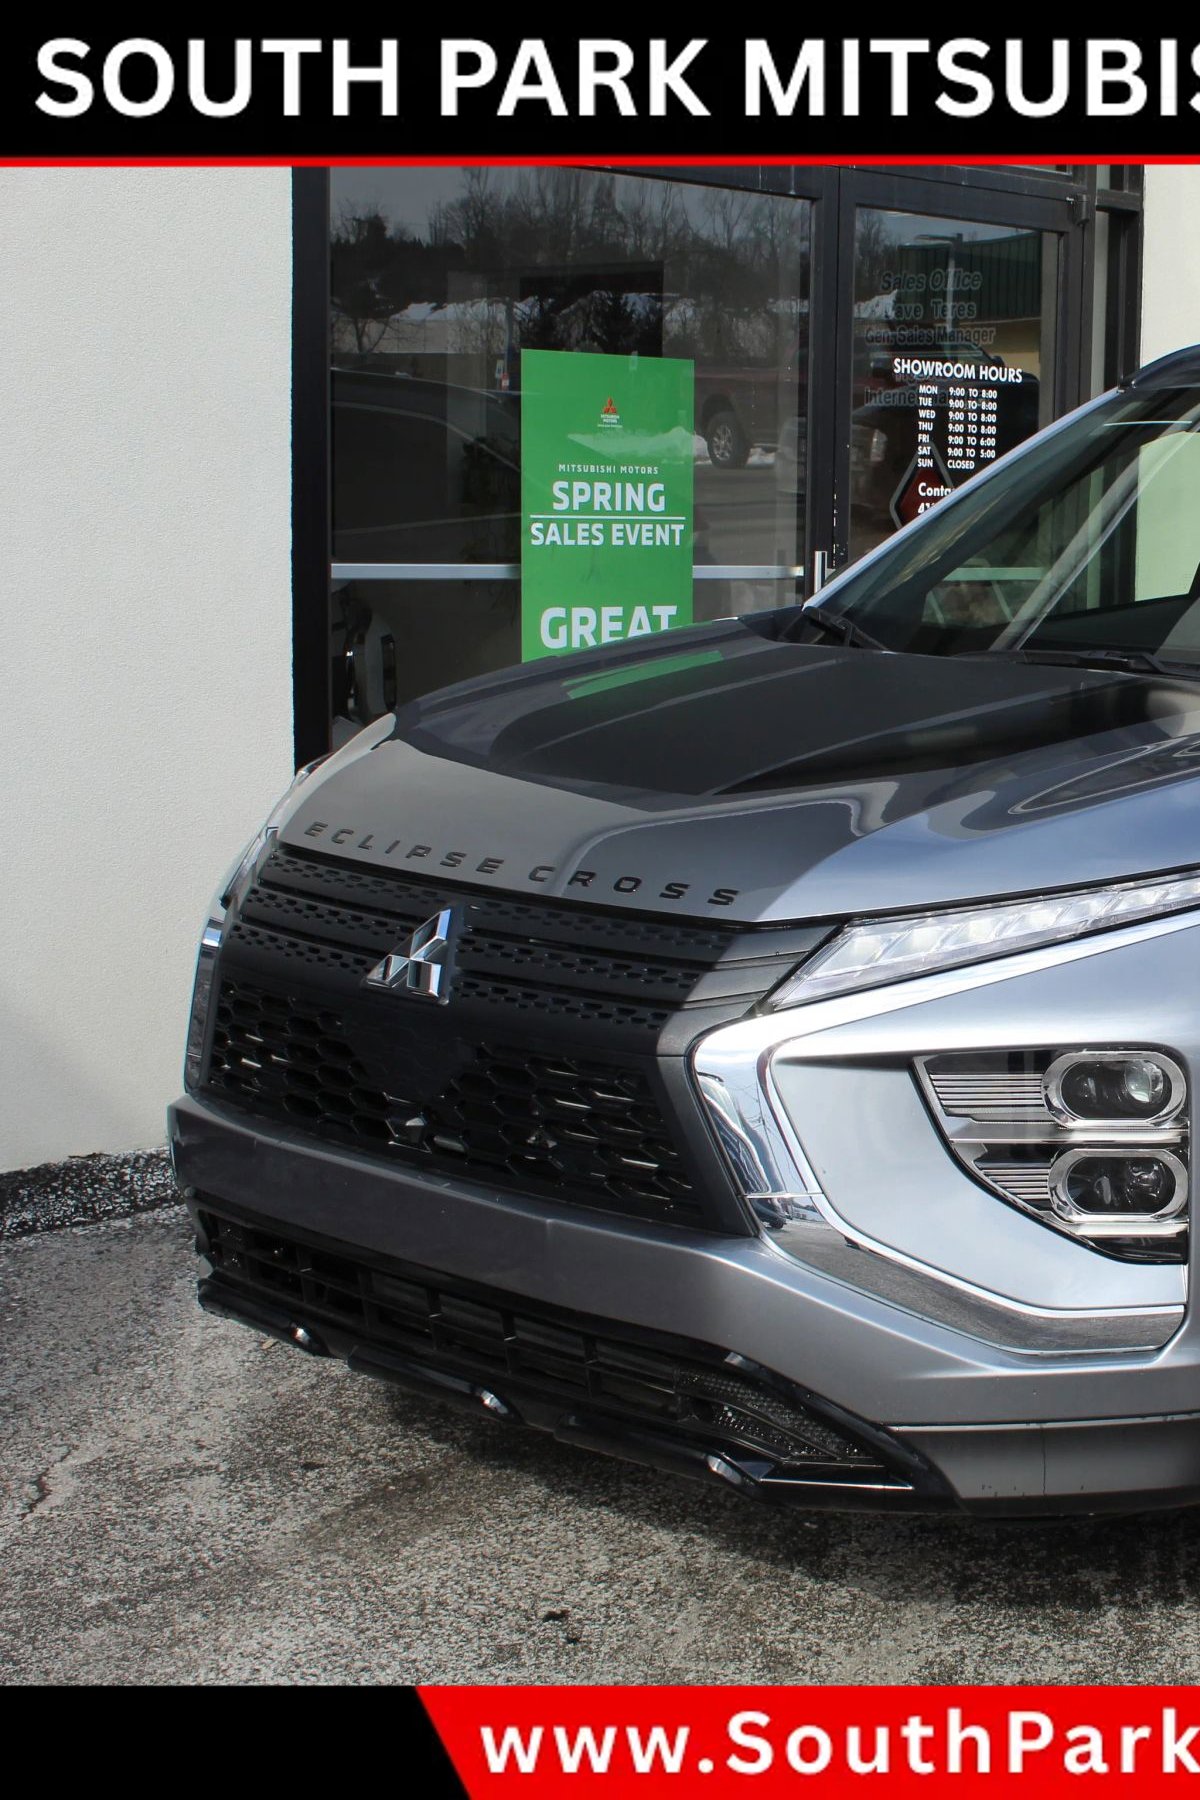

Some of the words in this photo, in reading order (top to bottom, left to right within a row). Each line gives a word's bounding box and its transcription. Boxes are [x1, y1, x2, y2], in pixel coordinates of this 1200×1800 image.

[881, 271, 926, 291] Sales
[896, 326, 935, 345] Sales
[894, 358, 975, 379] SHOWROOM
[979, 367, 1022, 383] HOURS
[919, 385, 938, 394] MON
[949, 388, 965, 397] 9:00
[969, 389, 978, 398] TO
[982, 390, 997, 399] 8:00
[919, 397, 932, 406] TUE
[949, 399, 965, 409] 9:00
[968, 401, 978, 409] TO
[982, 401, 997, 411] 8:00
[919, 410, 936, 418] WED
[948, 411, 964, 421] 9:00
[968, 413, 978, 421] TO
[981, 414, 997, 423] 8:00
[918, 422, 933, 431] THU
[948, 423, 964, 433] 9:00
[968, 425, 977, 433] TO
[981, 425, 997, 435] 8:00
[918, 434, 929, 443] FRI
[948, 435, 964, 445] 9:00
[967, 437, 976, 445] TO
[980, 437, 996, 446] 6:00
[918, 446, 931, 455] SAT
[947, 448, 963, 457] 9:00
[966, 449, 976, 457] TO
[980, 449, 996, 458] 5:00
[558, 464, 616, 473] MITSUBISHI
[620, 466, 659, 474] MOTORS
[918, 458, 933, 467] SUN
[947, 460, 975, 469] CLOSED
[552, 481, 665, 512] SPRING
[918, 483, 953, 497] Conta
[531, 523, 604, 546] SALES
[612, 524, 684, 546] EVENT
[540, 606, 678, 649] GREAT
[304, 822, 505, 874] ECLIPSE
[528, 865, 742, 906] CROSS
